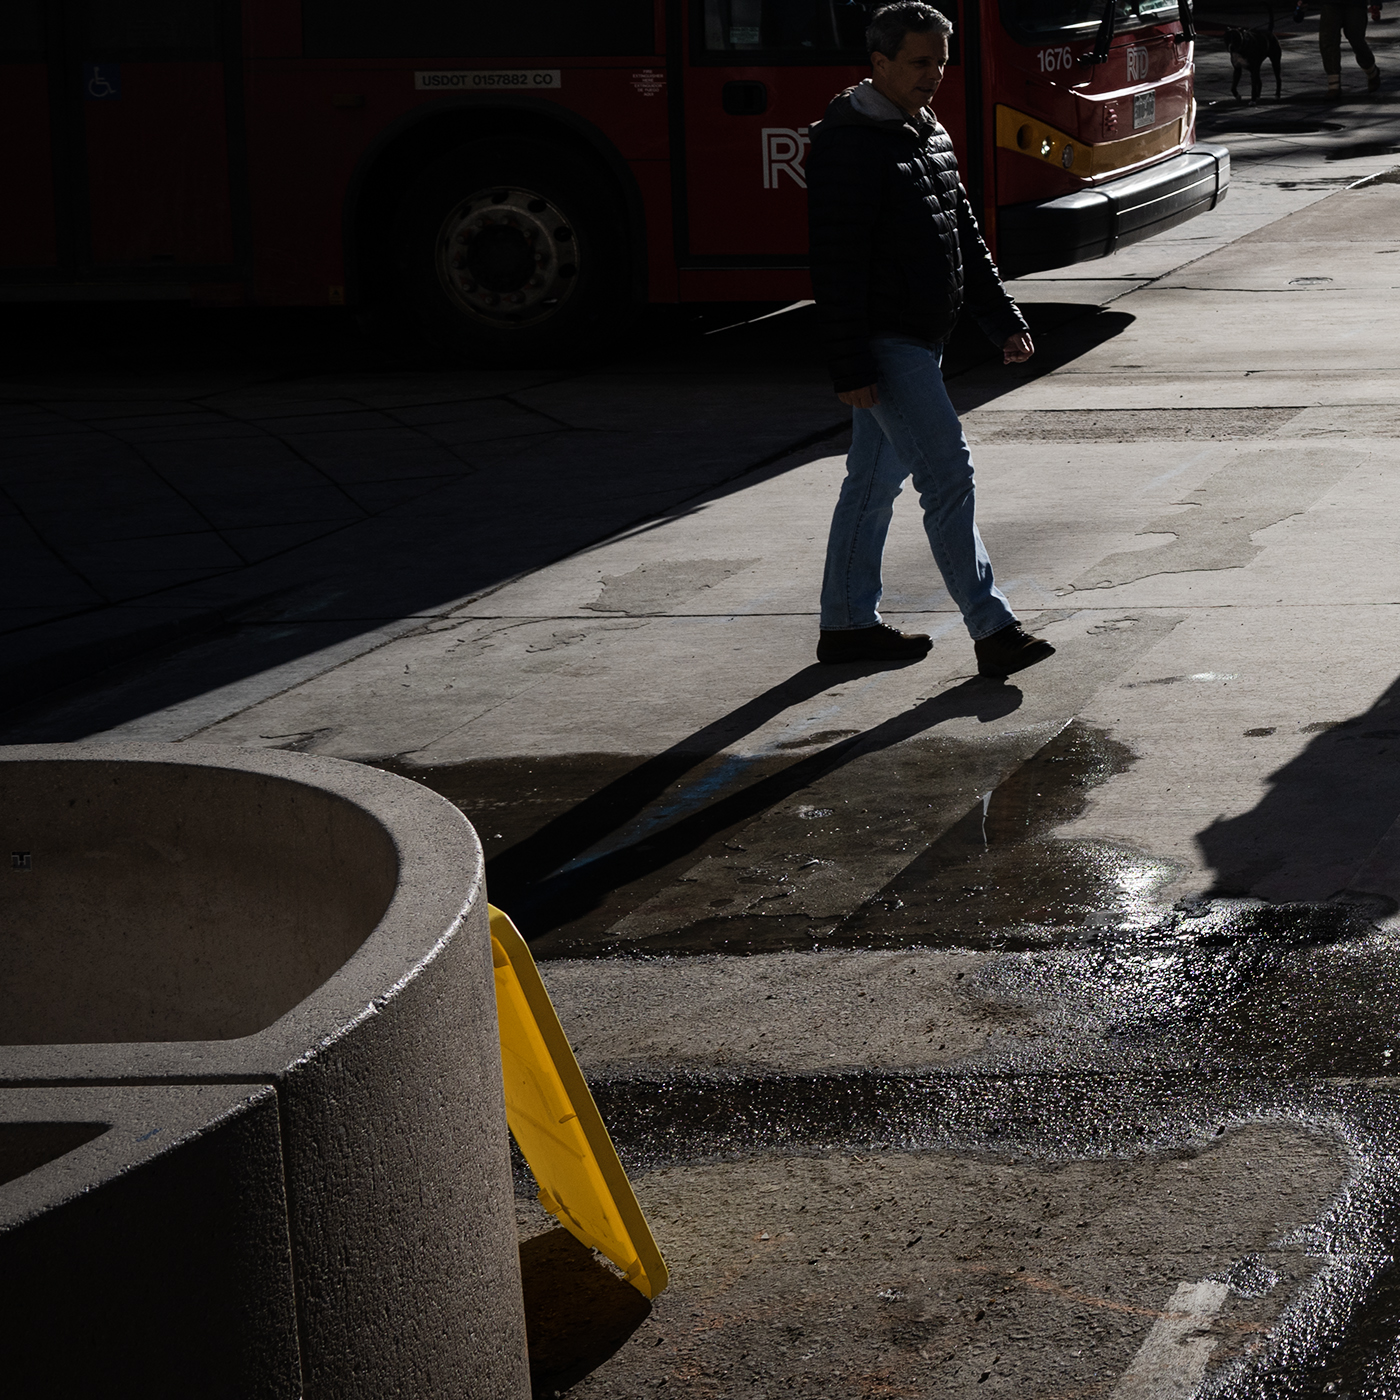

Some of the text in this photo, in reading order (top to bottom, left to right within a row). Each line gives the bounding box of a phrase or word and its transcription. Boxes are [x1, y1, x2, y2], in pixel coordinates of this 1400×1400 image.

[1037, 46, 1073, 73] 1676
[1126, 45, 1149, 82] RTD
[422, 73, 553, 86] USDOT 0157882 CO
